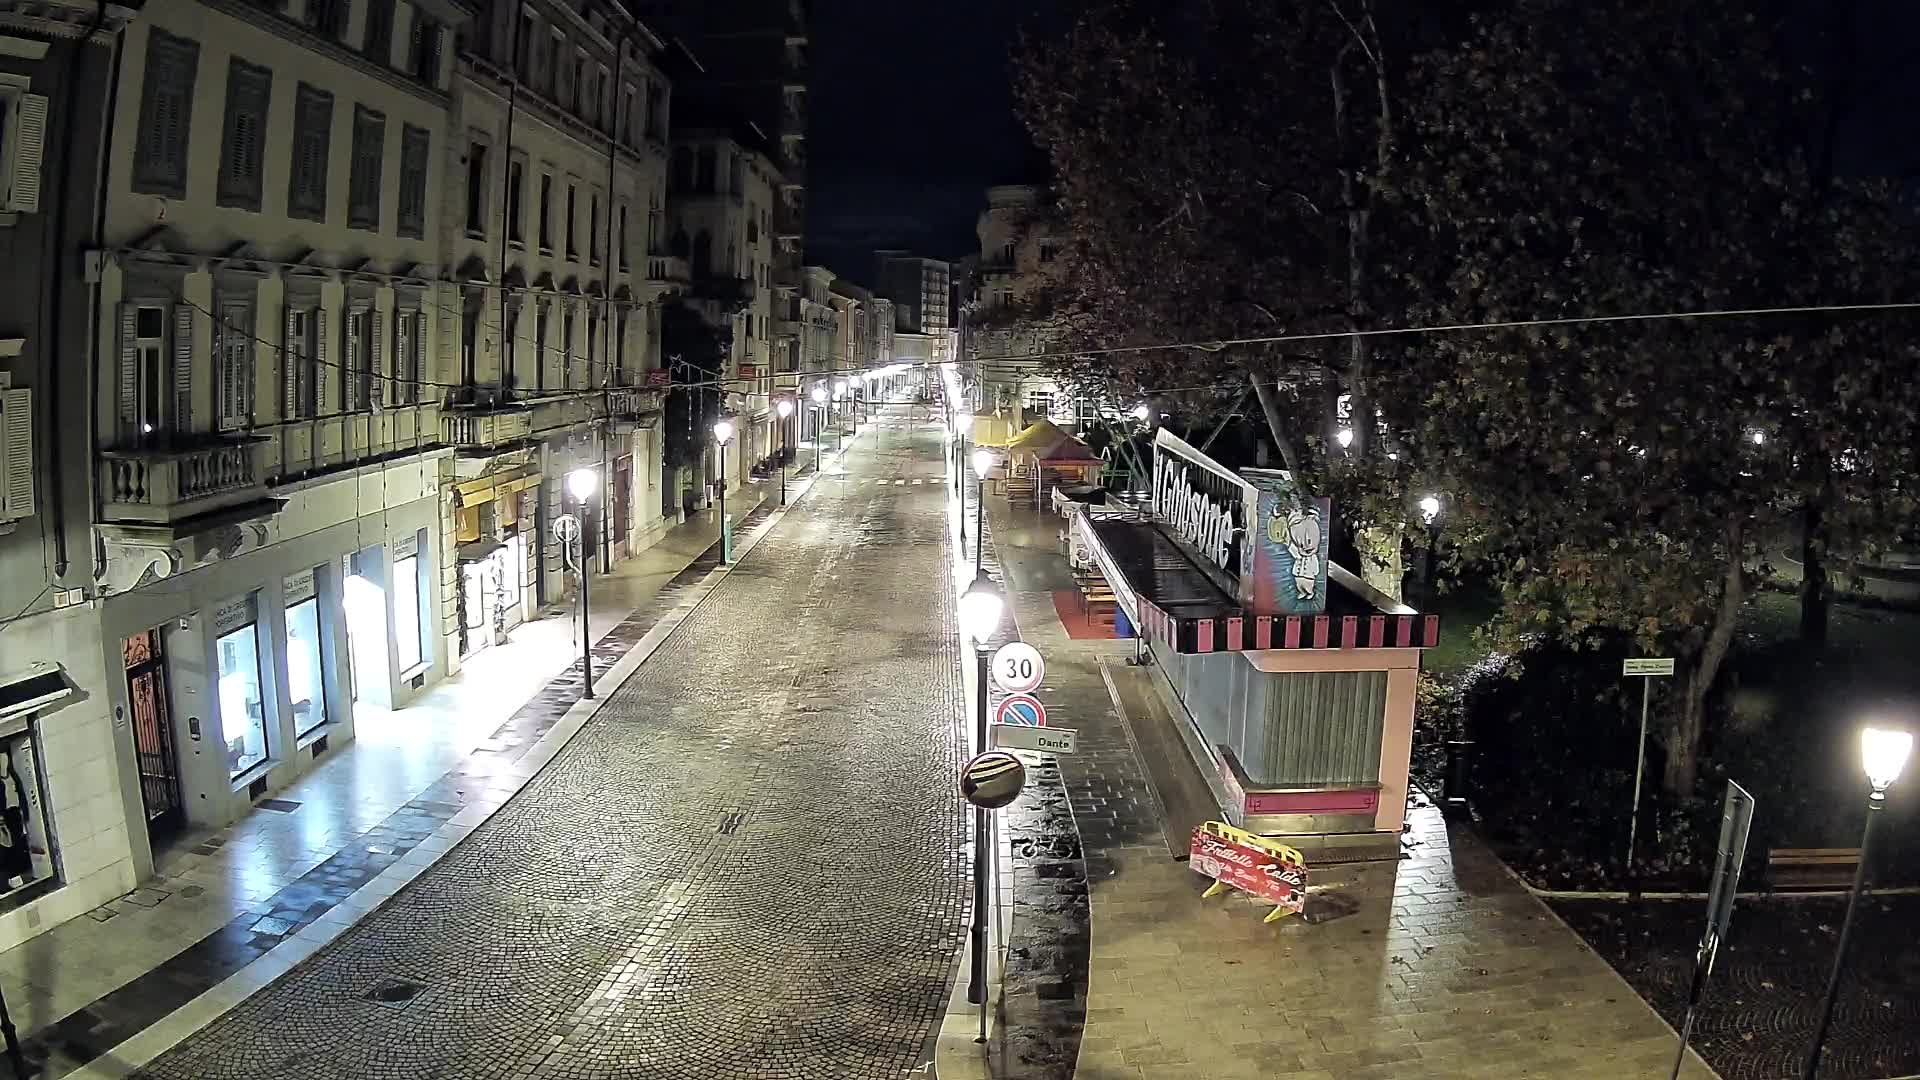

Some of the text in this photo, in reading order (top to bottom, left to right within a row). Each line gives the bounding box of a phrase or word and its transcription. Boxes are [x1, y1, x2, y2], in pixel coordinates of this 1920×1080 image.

[1162, 458, 1233, 570] Golosone
[1006, 658, 1032, 679] 30
[1038, 737, 1069, 749] Dante
